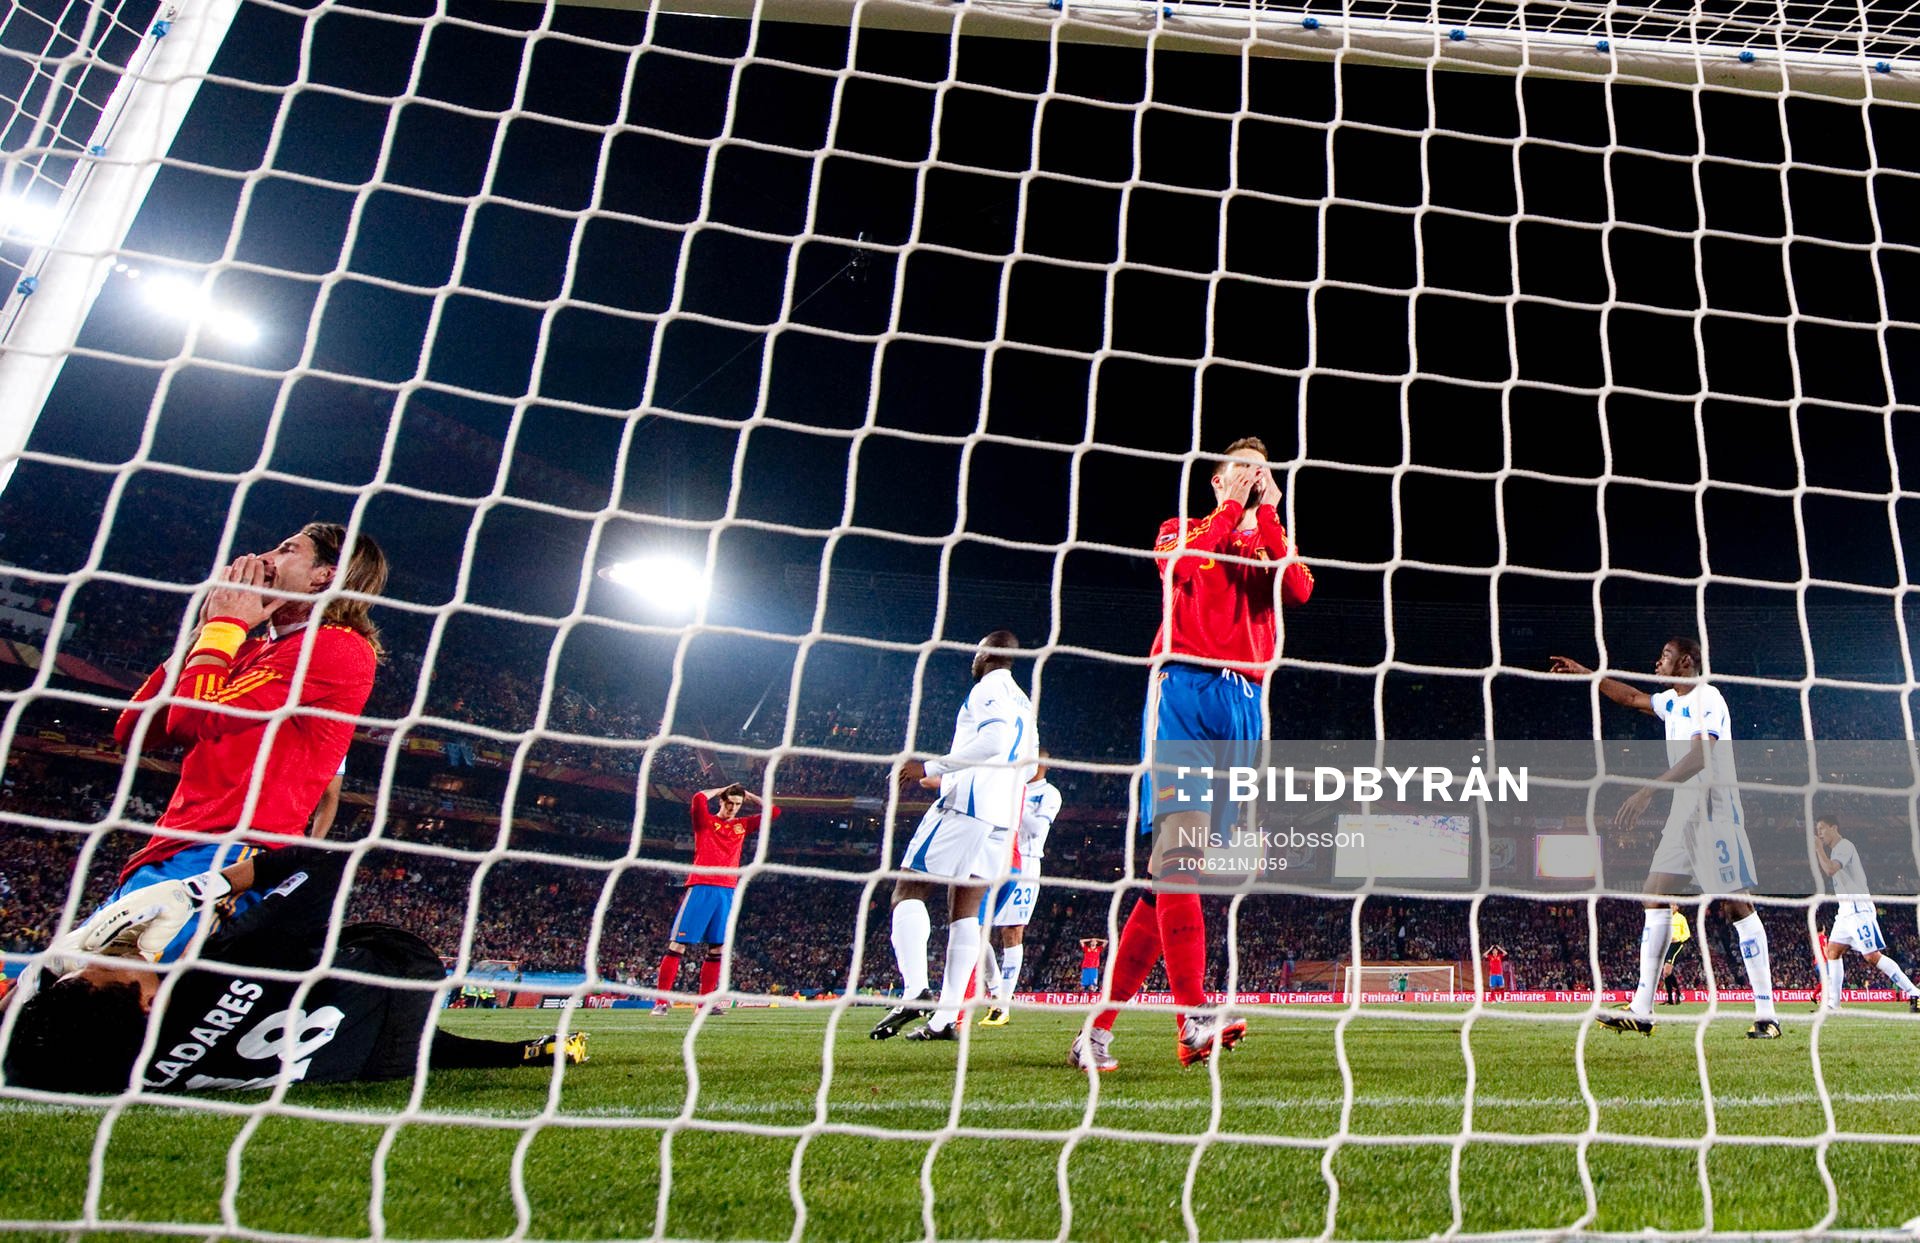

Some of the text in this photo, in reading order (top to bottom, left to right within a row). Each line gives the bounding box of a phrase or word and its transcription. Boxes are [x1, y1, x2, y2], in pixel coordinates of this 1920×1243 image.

[1008, 715, 1024, 761] 2
[1715, 839, 1731, 864] 3
[1013, 887, 1031, 905] 23
[1856, 924, 1872, 941] 13
[1046, 993, 1101, 1004] Fly Emirat
[1141, 993, 1175, 1003] Emira
[1215, 993, 1260, 1003] Emrates
[1270, 993, 1333, 1004] Fly Emirates
[1414, 992, 1476, 1003] Fly Emrates
[1485, 991, 1546, 1003] Fy Emirates
[1555, 992, 1616, 1003] Fly Emites
